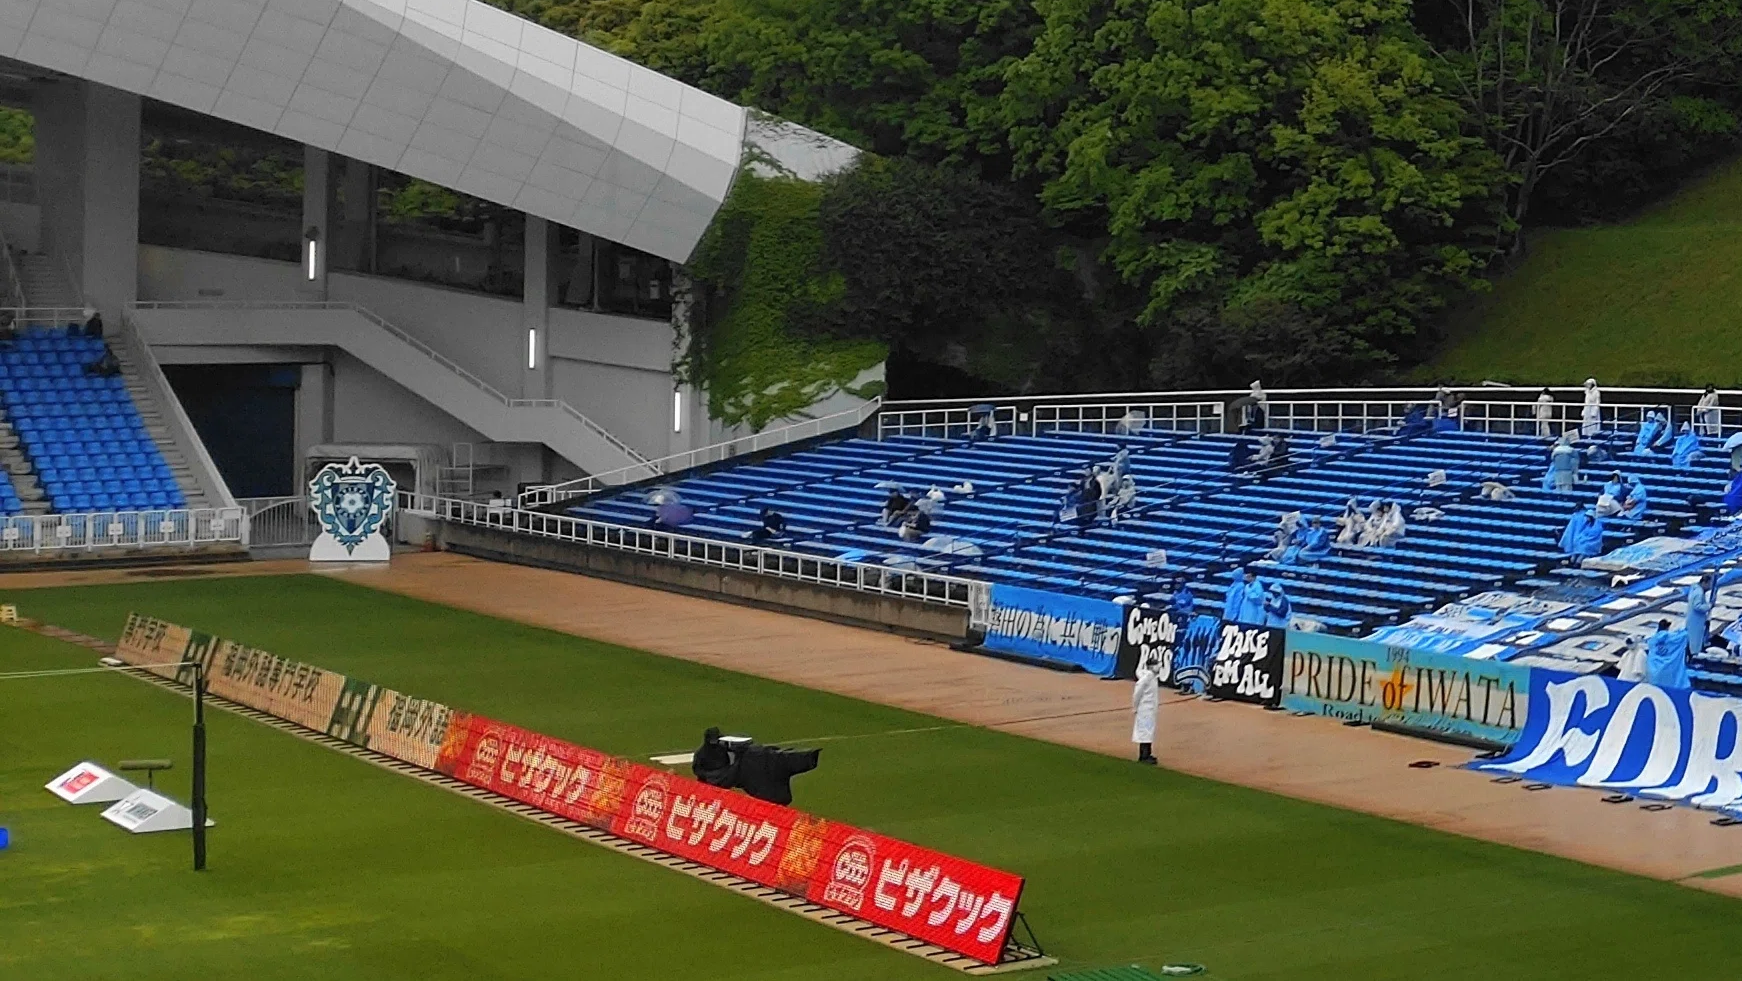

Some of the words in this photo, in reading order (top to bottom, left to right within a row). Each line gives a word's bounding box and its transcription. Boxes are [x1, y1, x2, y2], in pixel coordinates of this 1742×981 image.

[1216, 624, 1270, 662] TAKE
[1236, 663, 1275, 699] ALL
[1288, 650, 1378, 708] PRIDE
[1382, 663, 1411, 711] of
[1414, 667, 1520, 730] IWATA
[500, 740, 591, 806] ピザクック
[665, 793, 779, 867] ピザクック
[873, 857, 1015, 945] ピザクック
